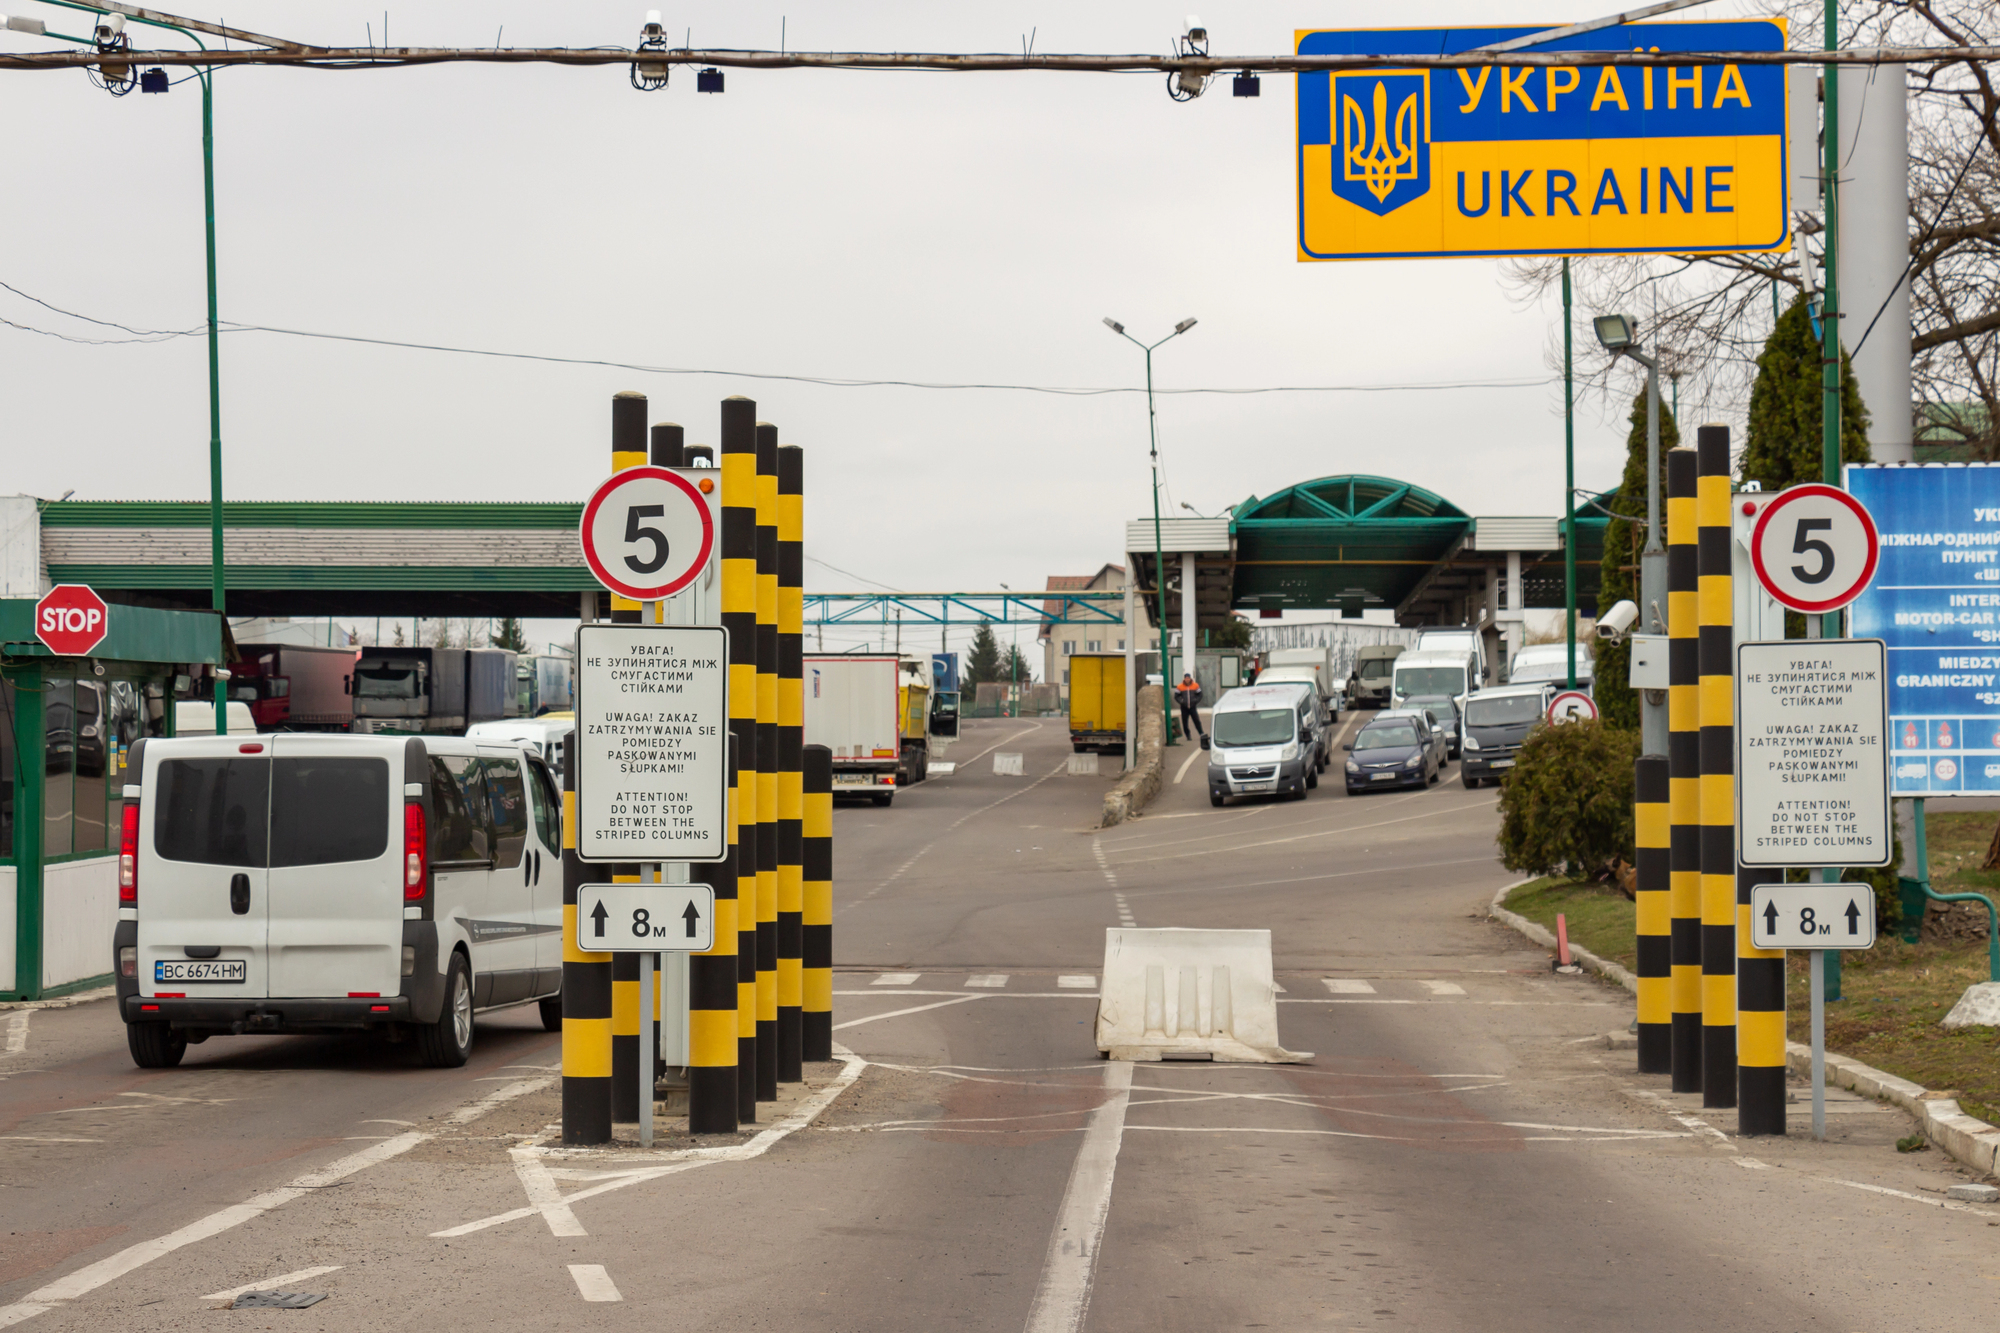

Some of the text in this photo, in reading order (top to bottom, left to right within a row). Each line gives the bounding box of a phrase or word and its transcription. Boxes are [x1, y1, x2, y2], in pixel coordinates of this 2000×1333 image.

[1457, 166, 1735, 218] UKRAINE
[1973, 508, 2000, 522] УК
[624, 505, 669, 574] 5
[1791, 518, 1835, 584] 5
[1942, 551, 1997, 563] ПУНКТ
[42, 607, 101, 632] STOP
[1895, 612, 1994, 625] MOTOR-CAR
[631, 646, 673, 655] УВАГА!
[588, 658, 717, 668] НЕ ЗУПИНЯТИСЯ МІЖ
[1790, 661, 1831, 669] УВАГА!
[611, 671, 692, 680] СМУГАСТИМИ
[1748, 672, 1875, 682] НЕ ЗУПИНЯТИСЯ МІЖ
[1896, 675, 1995, 687] GRANICZNY
[621, 682, 682, 693] СТІЙКАМИ
[1772, 685, 1852, 694] СМУГАСТИМИ
[1782, 696, 1842, 706] СТІЙКАМИ
[606, 713, 697, 722] UWAGA! ZAKAZ
[589, 725, 692, 735] ZATRZYMYWANIA
[1767, 724, 1858, 734] UWAGA! ZAKAZ
[1750, 736, 1876, 746] ZATRZYMYWANIA SIE
[1905, 736, 1916, 746] 11
[1939, 736, 1951, 746] 10
[608, 751, 696, 761] PASKOWANYMI
[1770, 761, 1857, 770] PASKOWANYMI
[1938, 765, 1954, 774] CD
[616, 792, 687, 801] ATTENTION!
[611, 805, 692, 814] DO NOT STOP
[1778, 801, 1850, 809] ATTENTION!
[1773, 812, 1855, 822] DO NOT STOP
[610, 818, 694, 827] BETWEEN THE
[596, 830, 708, 839] STRIPED COLUMNS
[1771, 825, 1857, 834] BETWEEN THE
[1757, 837, 1872, 846] STRIPED COLUMNS
[165, 964, 242, 978] BC 6674 HM
